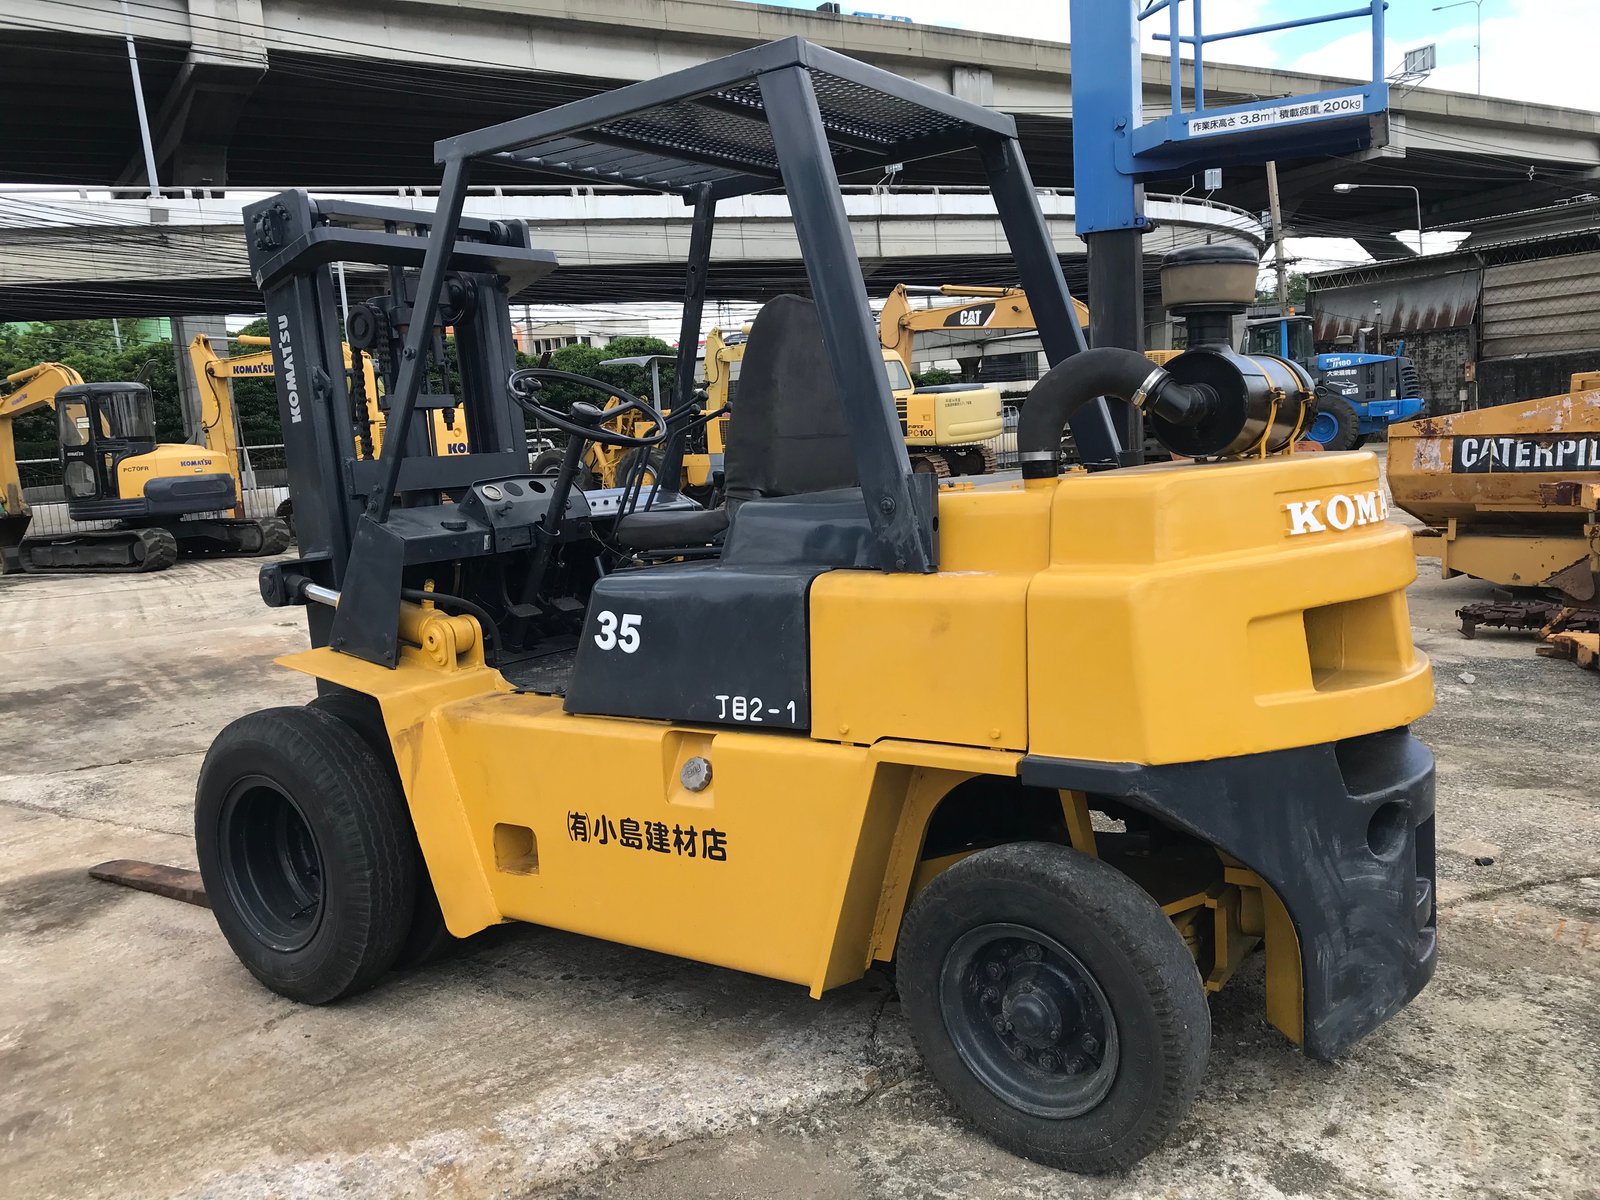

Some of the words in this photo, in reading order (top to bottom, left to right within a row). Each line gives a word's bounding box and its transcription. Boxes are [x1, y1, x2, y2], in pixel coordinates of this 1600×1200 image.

[1193, 117, 1236, 132] 作業床高さ
[1240, 113, 1270, 125] 3.8m
[1323, 100, 1361, 114] 200kg
[960, 310, 982, 326] CAT
[233, 363, 274, 374] KOMATSU
[278, 315, 302, 424] KOMATSU
[908, 429, 934, 437] PC100
[448, 443, 469, 454] KO
[180, 459, 212, 467] KOMATSU
[123, 465, 149, 473] PC70FR
[594, 610, 642, 654] 35
